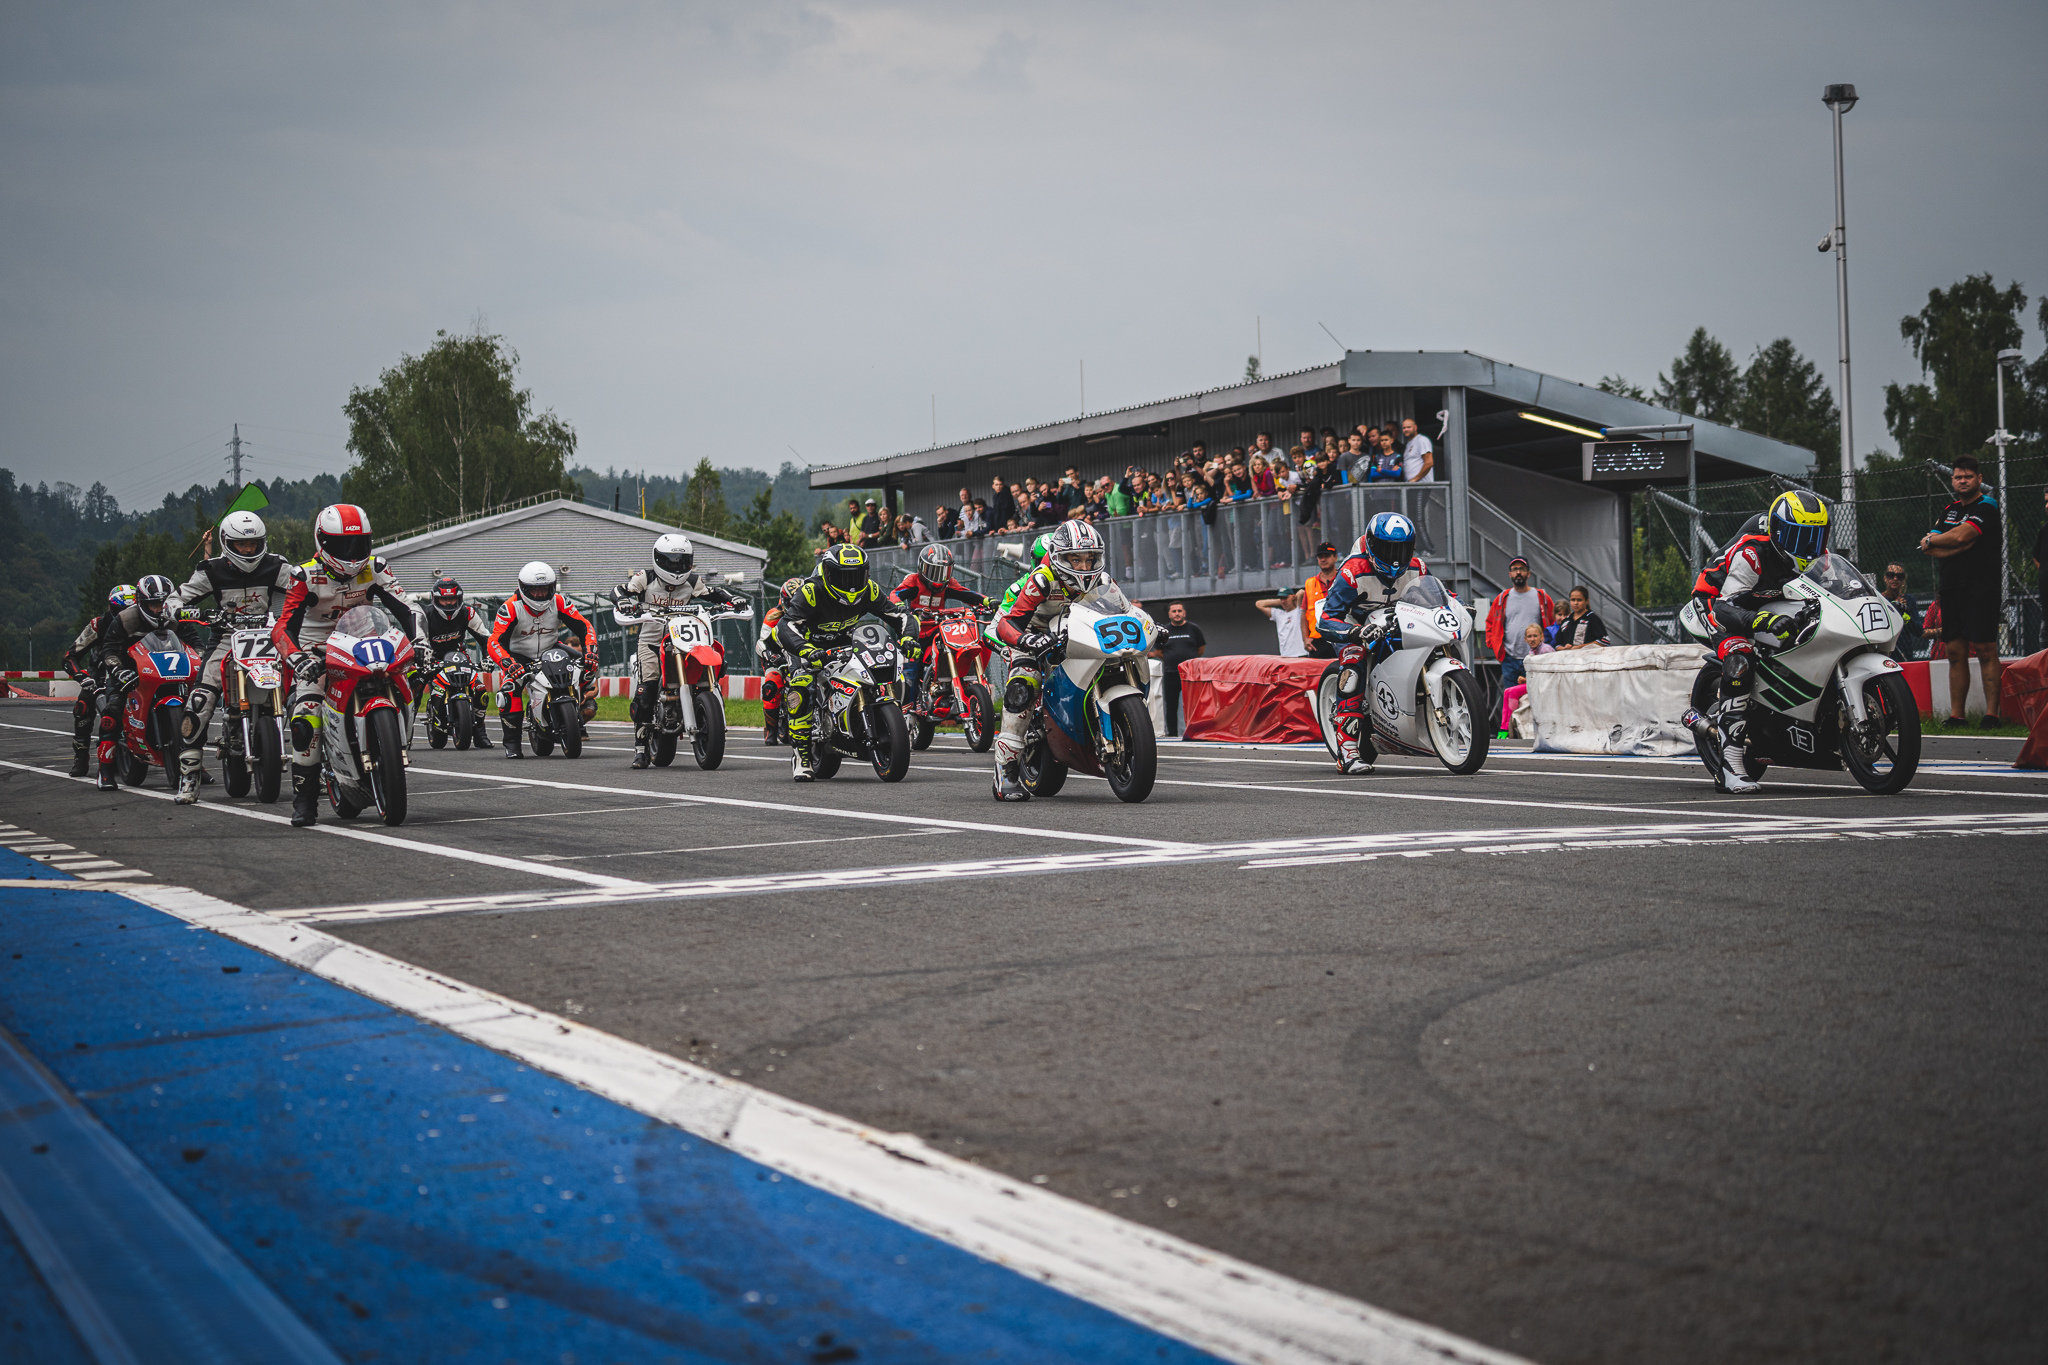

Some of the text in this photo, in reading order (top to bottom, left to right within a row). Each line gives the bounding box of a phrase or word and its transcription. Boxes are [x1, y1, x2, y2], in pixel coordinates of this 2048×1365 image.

[1384, 515, 1411, 536] A
[1438, 613, 1458, 628] 43
[1856, 602, 1890, 633] 13
[680, 624, 701, 642] 51
[862, 626, 880, 645] 9
[951, 623, 968, 635] 20
[1098, 620, 1141, 649] 59
[238, 638, 275, 658] 72
[360, 641, 386, 662] 11
[452, 653, 460, 662] 6
[547, 651, 561, 662] 16
[164, 653, 181, 671] 7
[1378, 687, 1397, 715] 43
[1786, 726, 1815, 754] 13
